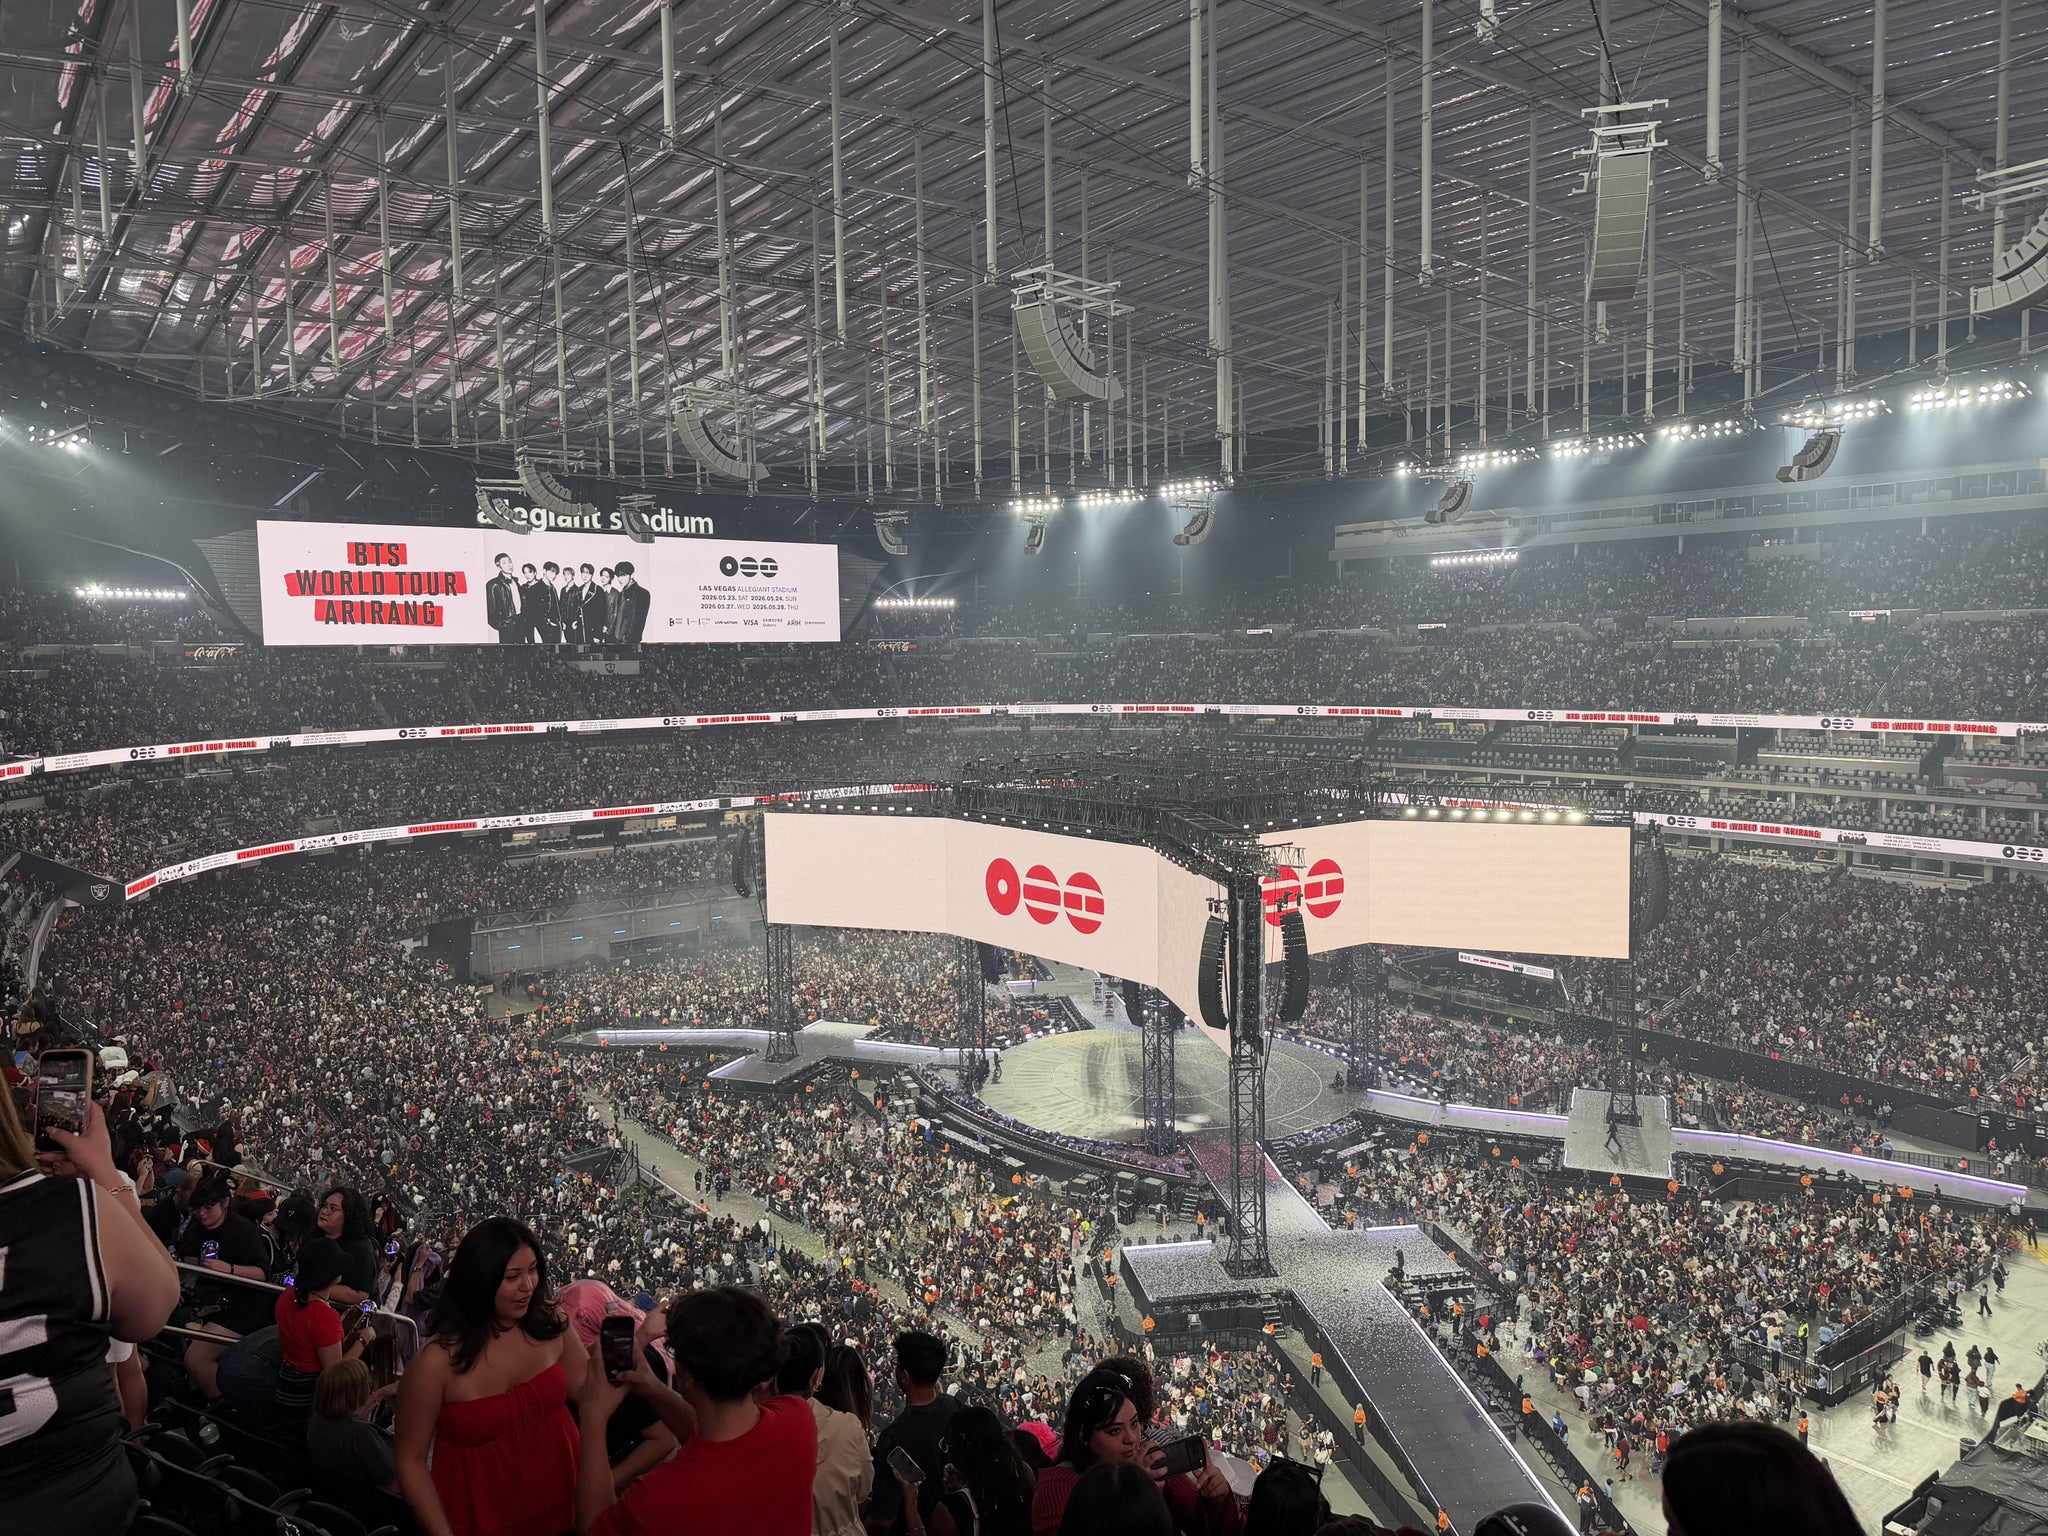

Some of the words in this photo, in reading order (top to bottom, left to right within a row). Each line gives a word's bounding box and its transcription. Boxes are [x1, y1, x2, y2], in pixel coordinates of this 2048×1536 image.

[610, 508, 714, 534] sdium
[355, 542, 401, 566] BTS
[296, 570, 386, 595] WORLD
[393, 571, 459, 596] TOUR
[325, 600, 435, 625] ARIRANG
[1627, 714, 1660, 722] ARIRANG
[1871, 721, 1890, 729] BTS
[1892, 722, 1924, 730] WORLD
[1926, 723, 1951, 731] TOUR
[1953, 724, 1997, 734] ARIRANG
[1710, 821, 1727, 829] BTS
[1729, 823, 1757, 832] WORLD
[1759, 825, 1781, 834] TOUR
[1783, 827, 1821, 839] ARIRANG
